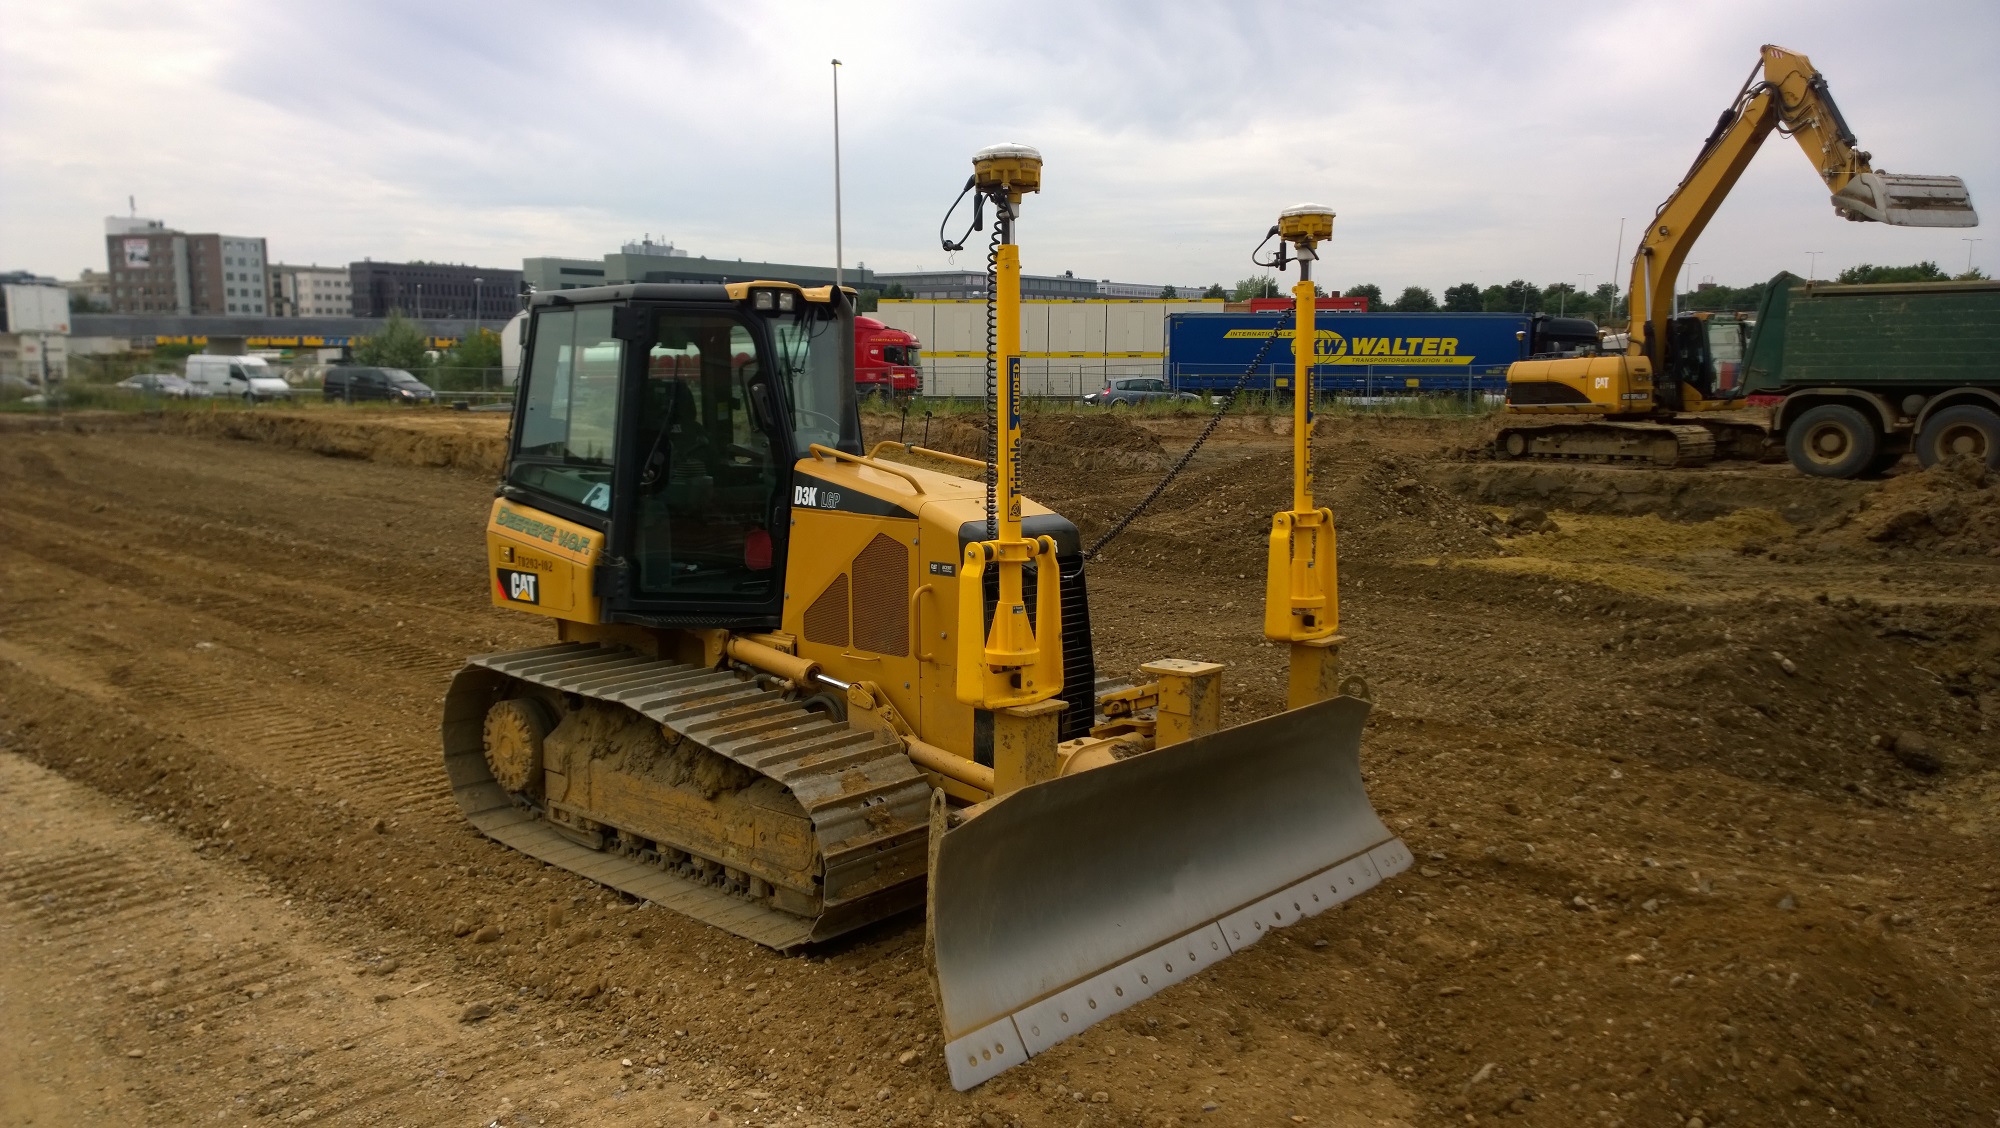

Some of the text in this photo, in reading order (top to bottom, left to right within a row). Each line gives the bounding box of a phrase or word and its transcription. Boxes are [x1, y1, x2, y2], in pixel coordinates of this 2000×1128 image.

[1352, 337, 1459, 355] WALTER
[1595, 376, 1609, 389] CAT
[1010, 438, 1021, 497] Trimble
[795, 486, 840, 508] D3K LGP
[510, 572, 536, 601] CAT
